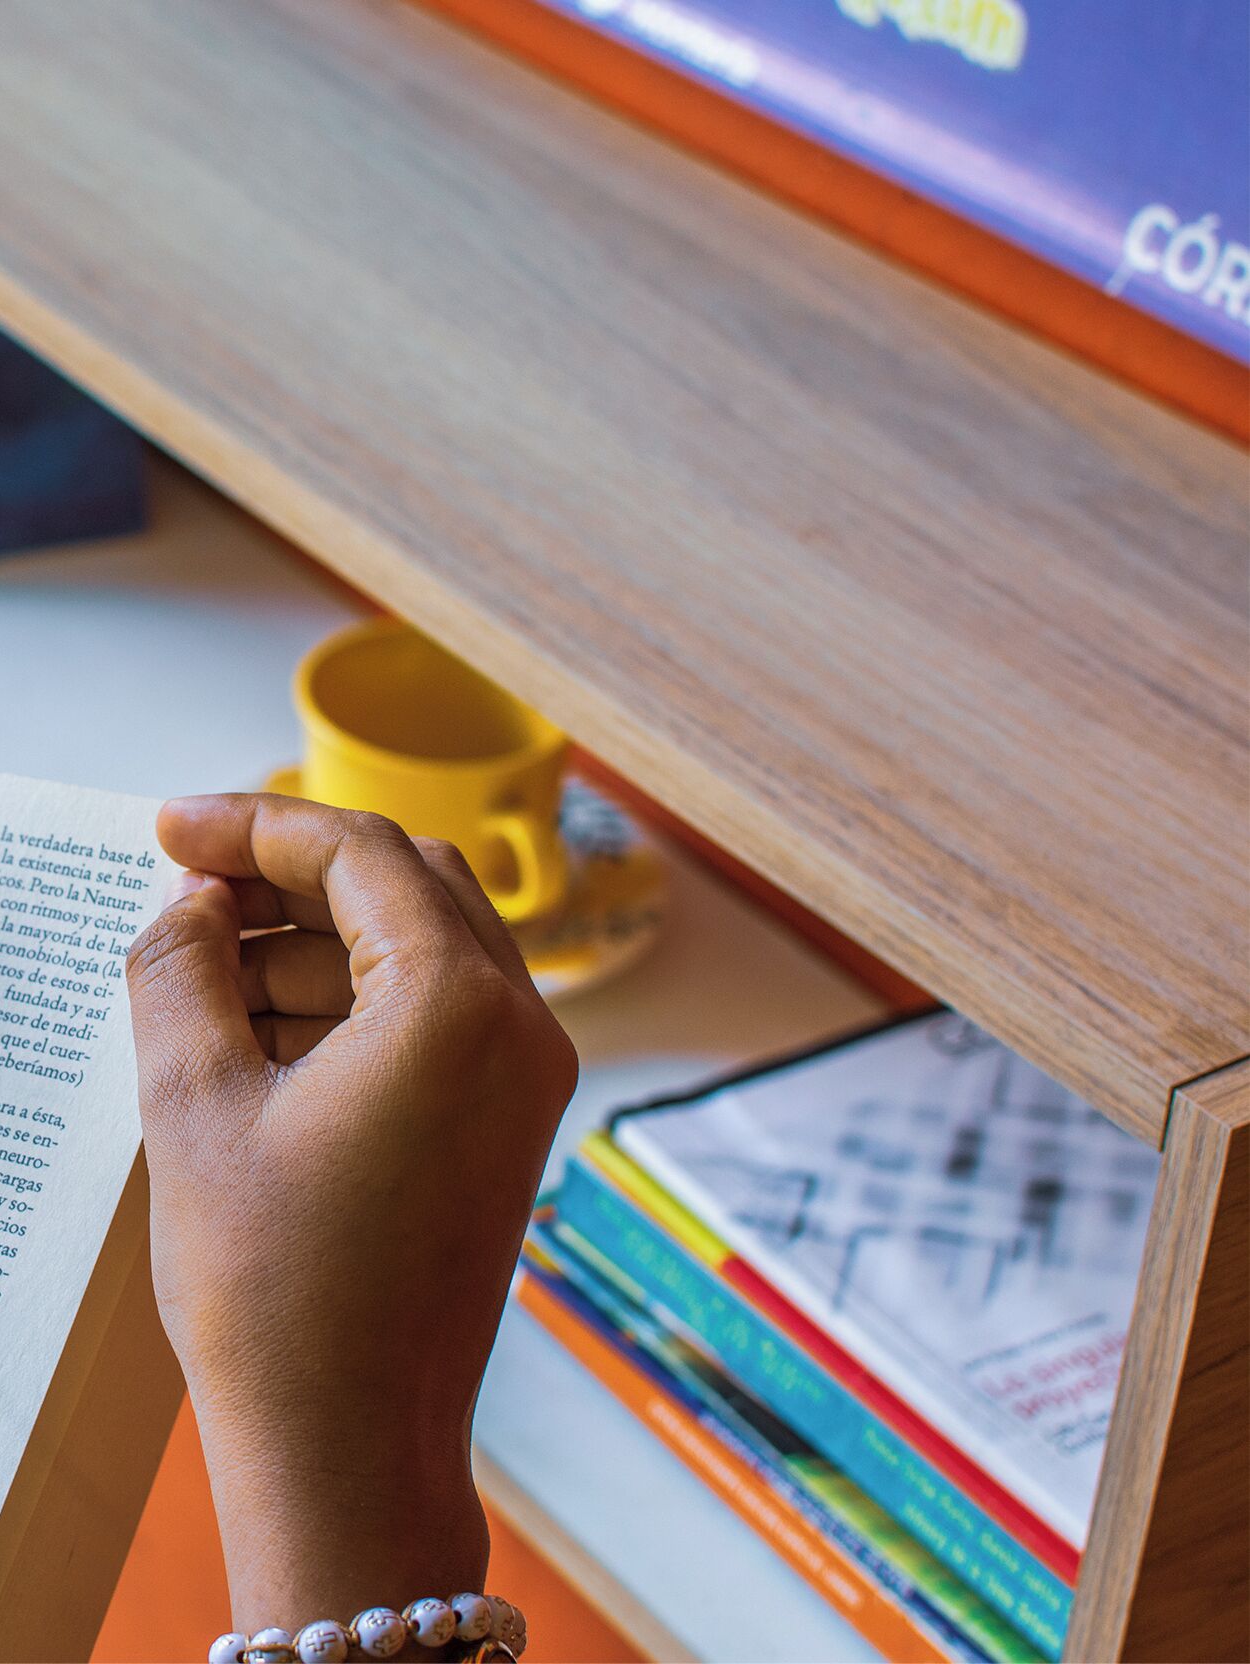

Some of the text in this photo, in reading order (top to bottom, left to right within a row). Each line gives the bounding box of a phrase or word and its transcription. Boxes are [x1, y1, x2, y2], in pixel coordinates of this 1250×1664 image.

[0, 847, 14, 865] la
[17, 856, 92, 881] existencia
[95, 871, 112, 884] se
[115, 869, 149, 890] fun-
[101, 959, 122, 979] (la
[29, 1012, 50, 1031] de
[51, 1022, 98, 1040] medi-
